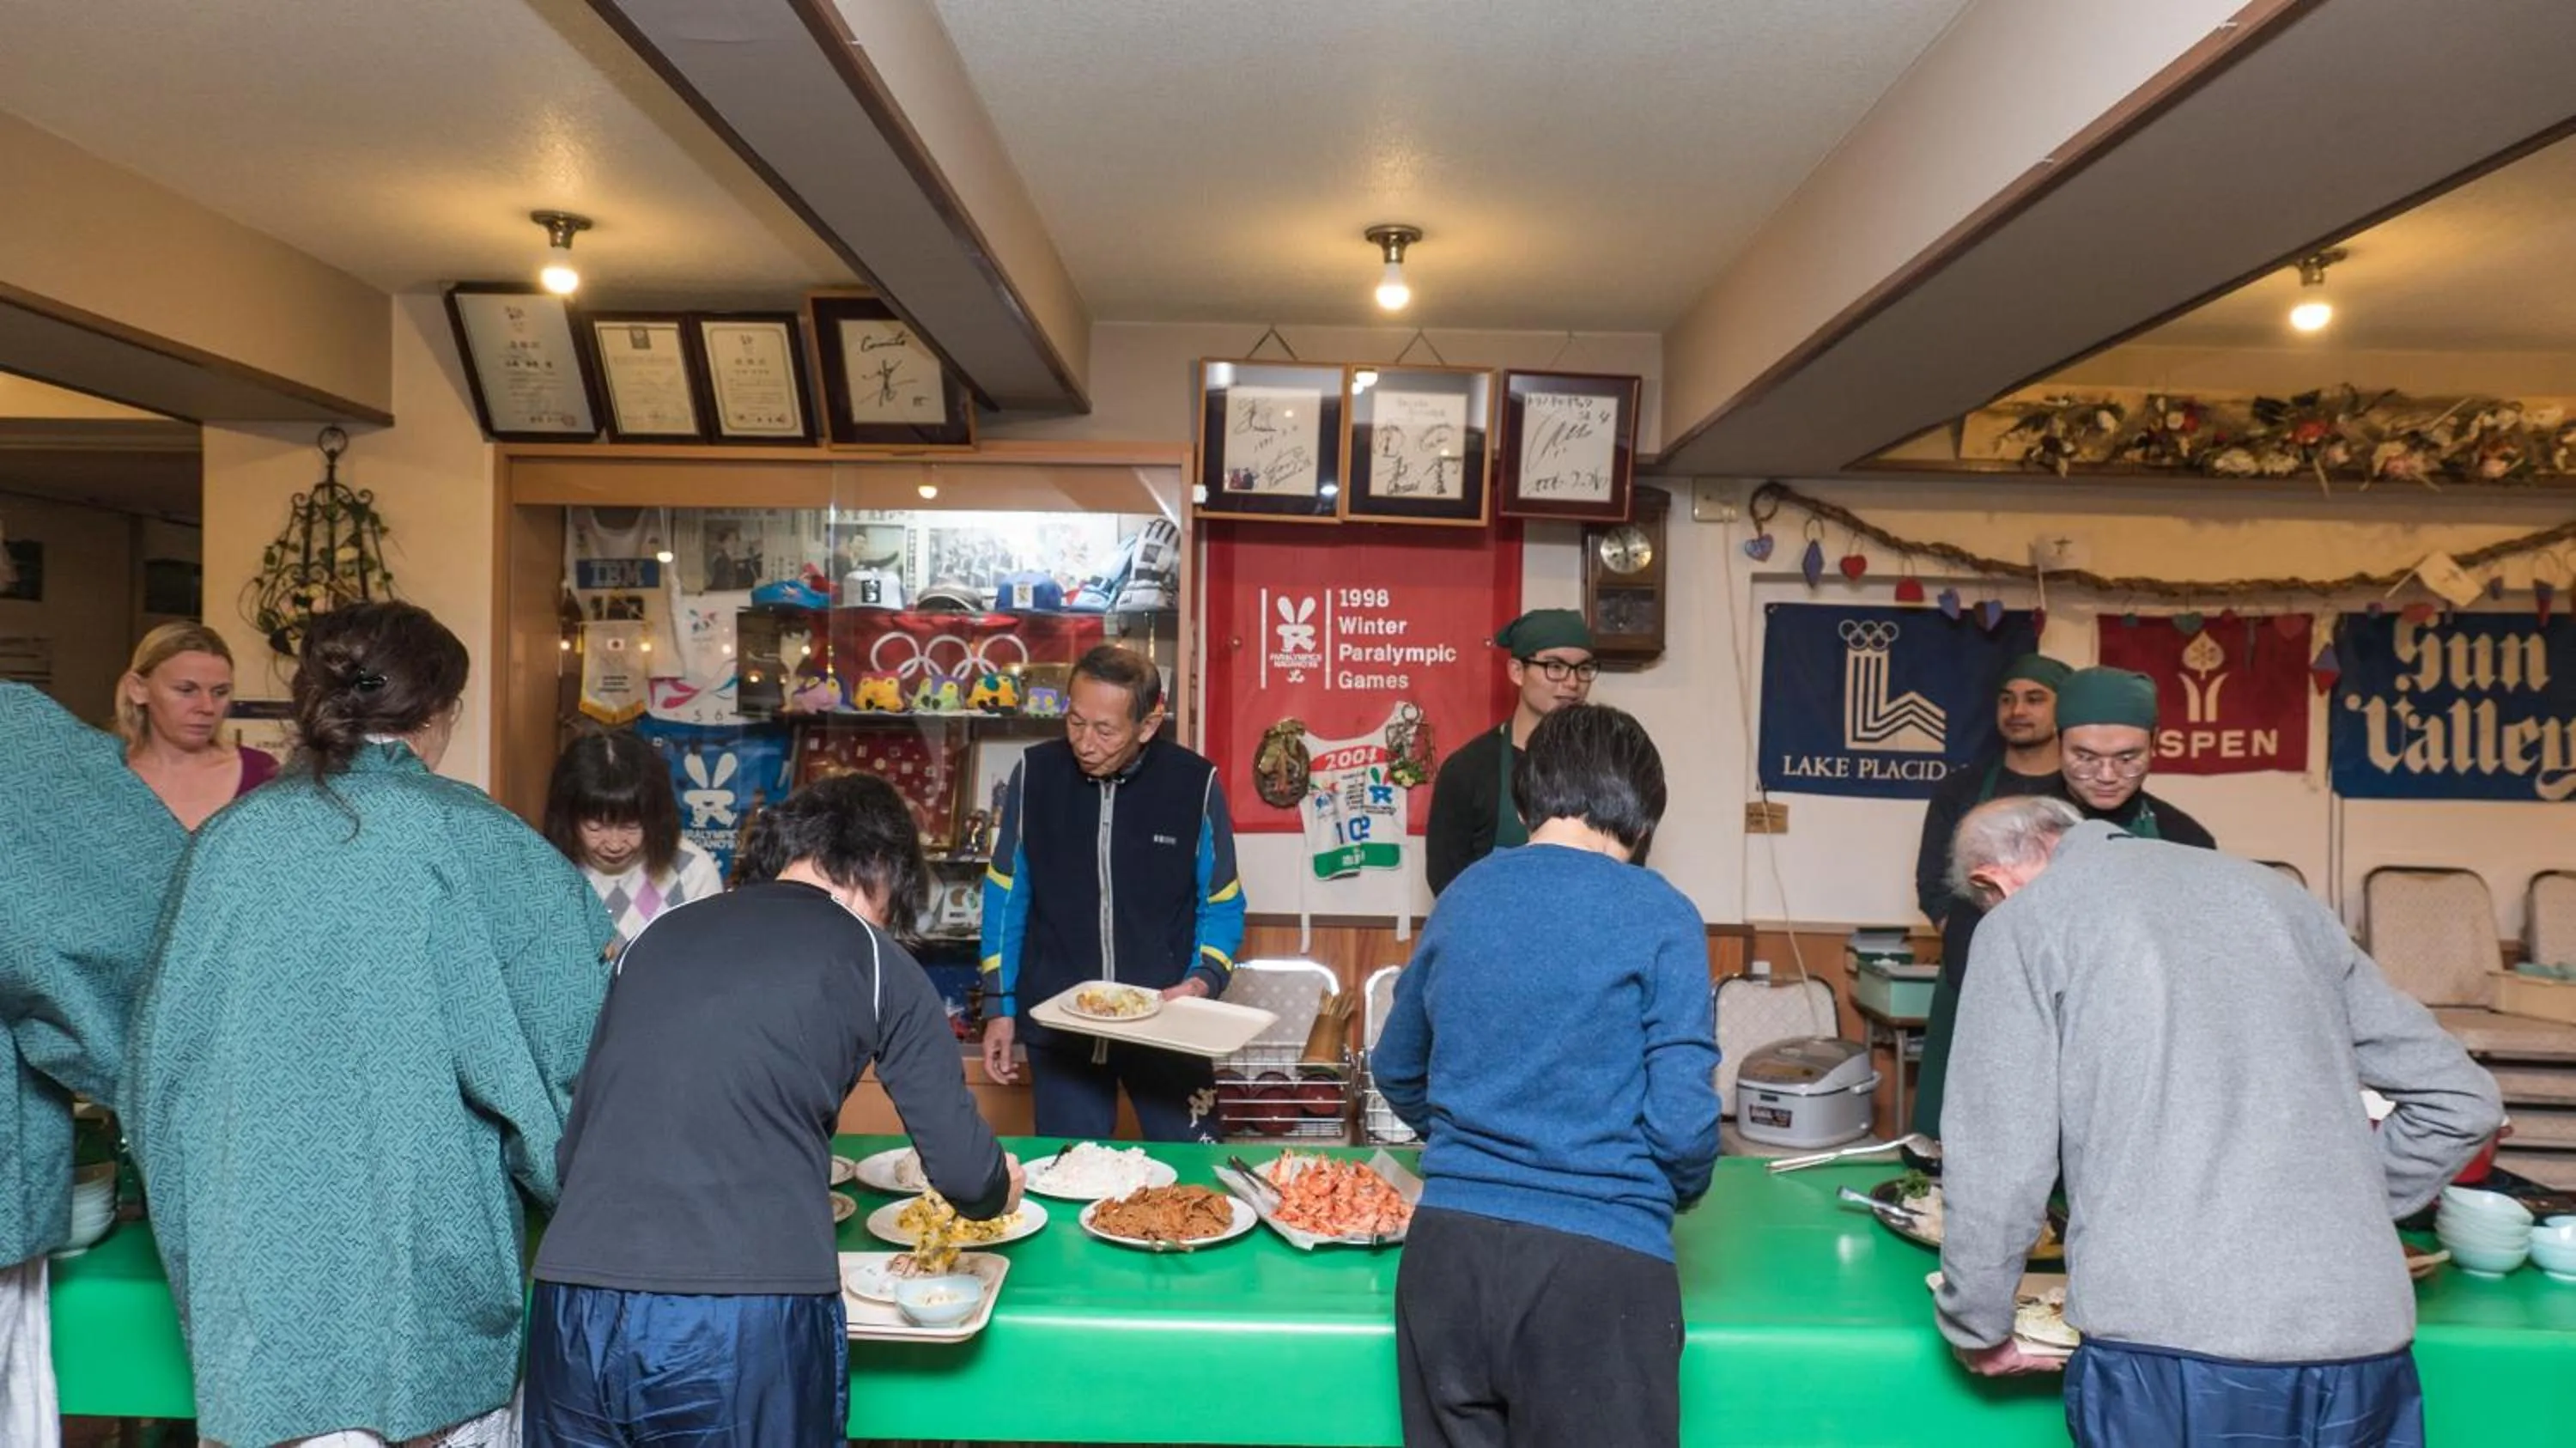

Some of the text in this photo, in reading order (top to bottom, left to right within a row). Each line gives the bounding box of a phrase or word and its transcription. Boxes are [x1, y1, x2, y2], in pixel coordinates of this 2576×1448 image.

[590, 561, 645, 587] IBM
[1338, 587, 1390, 608] 1998
[1338, 616, 1407, 636] Winter
[1338, 643, 1457, 667] Paralympic
[2392, 611, 2551, 693] Sun
[1338, 671, 1410, 690] Games
[1783, 754, 1850, 778] LAKE
[1857, 758, 1948, 782] PLACID
